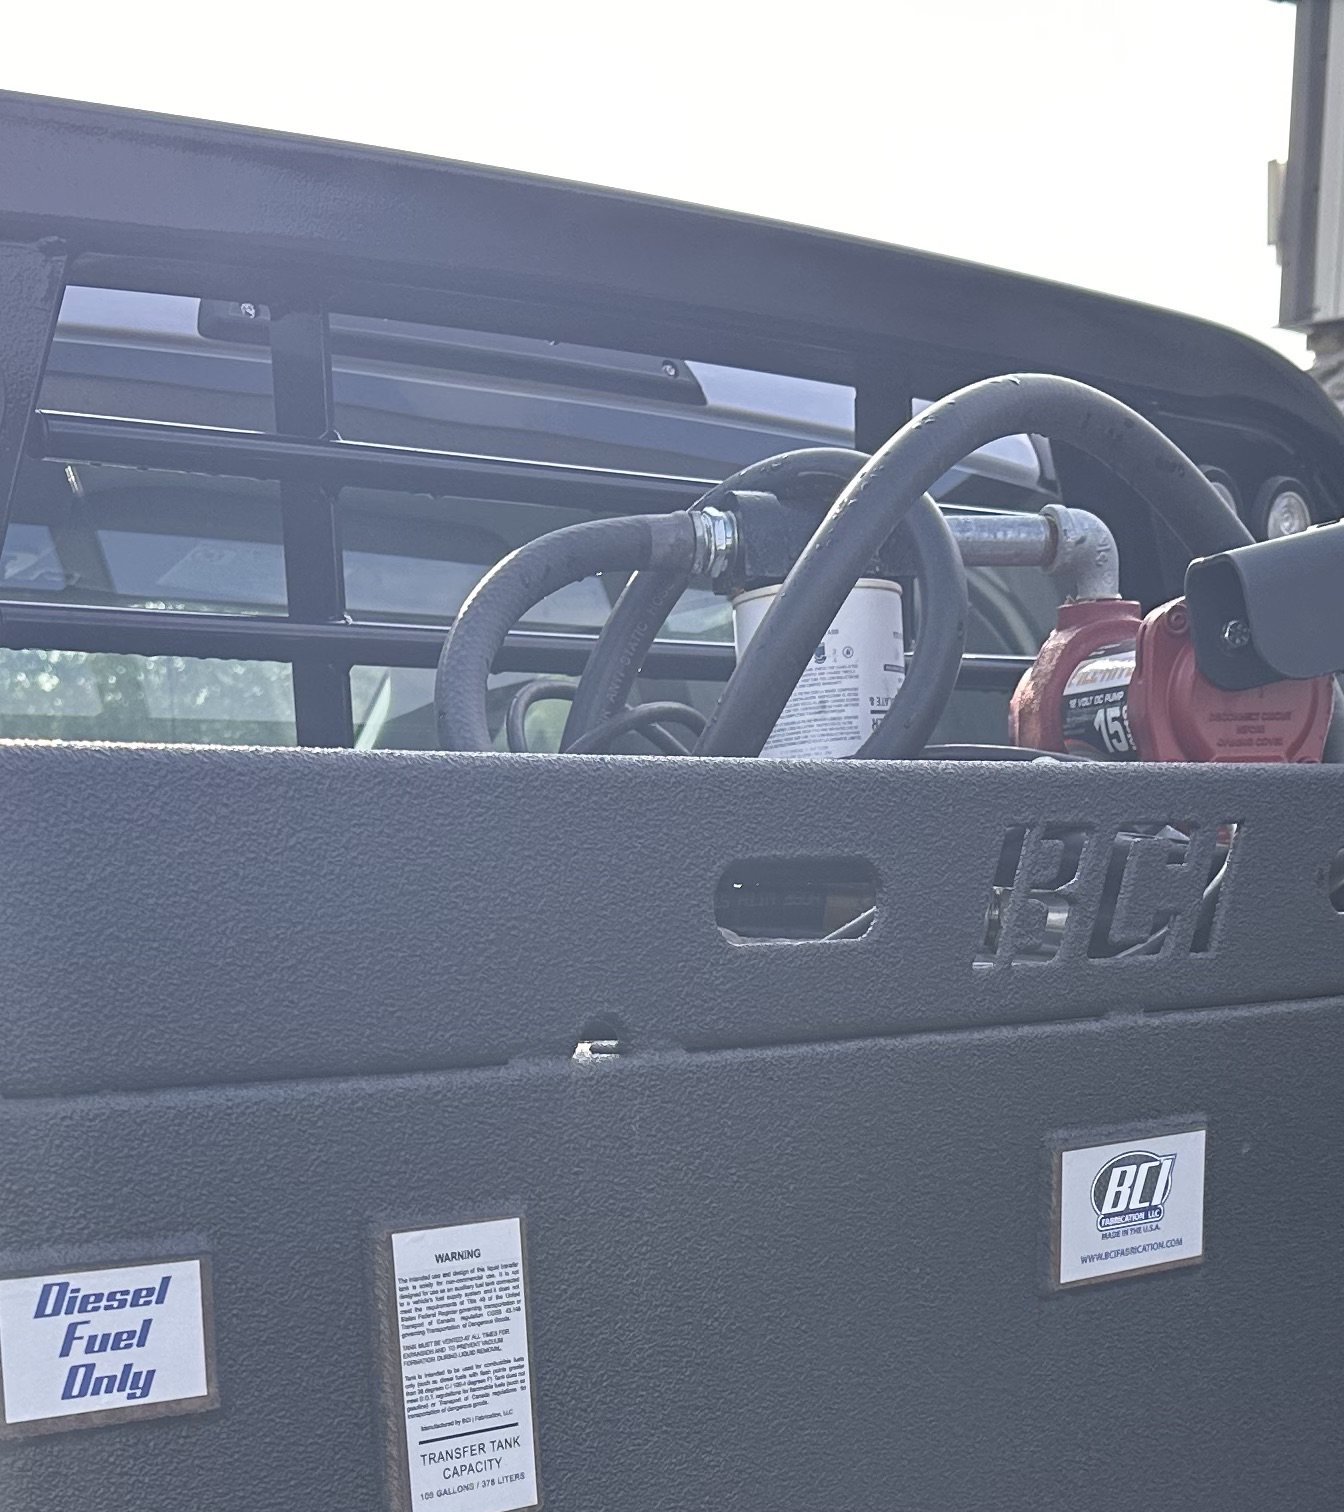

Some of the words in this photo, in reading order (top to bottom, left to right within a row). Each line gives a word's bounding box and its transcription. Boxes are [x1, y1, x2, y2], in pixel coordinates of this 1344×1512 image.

[973, 821, 1244, 968] BCI
[1101, 1158, 1173, 1214] BCI
[1101, 1212, 1145, 1227] FABRICATION
[1147, 1208, 1161, 1219] LLC
[1101, 1229, 1120, 1240] MADE
[1121, 1228, 1129, 1237] IN
[1130, 1226, 1142, 1236] THE
[434, 1248, 481, 1264] WARNING
[33, 1275, 172, 1319] Diesel
[58, 1318, 153, 1358] Fuel
[61, 1362, 156, 1400] Only
[420, 1442, 487, 1467] TRANSFER
[489, 1435, 521, 1451] TANK
[436, 1482, 475, 1498] GALLONS
[481, 1479, 496, 1489] 378
[497, 1471, 525, 1485] LITERS
[443, 1457, 503, 1480] CAPACITY
